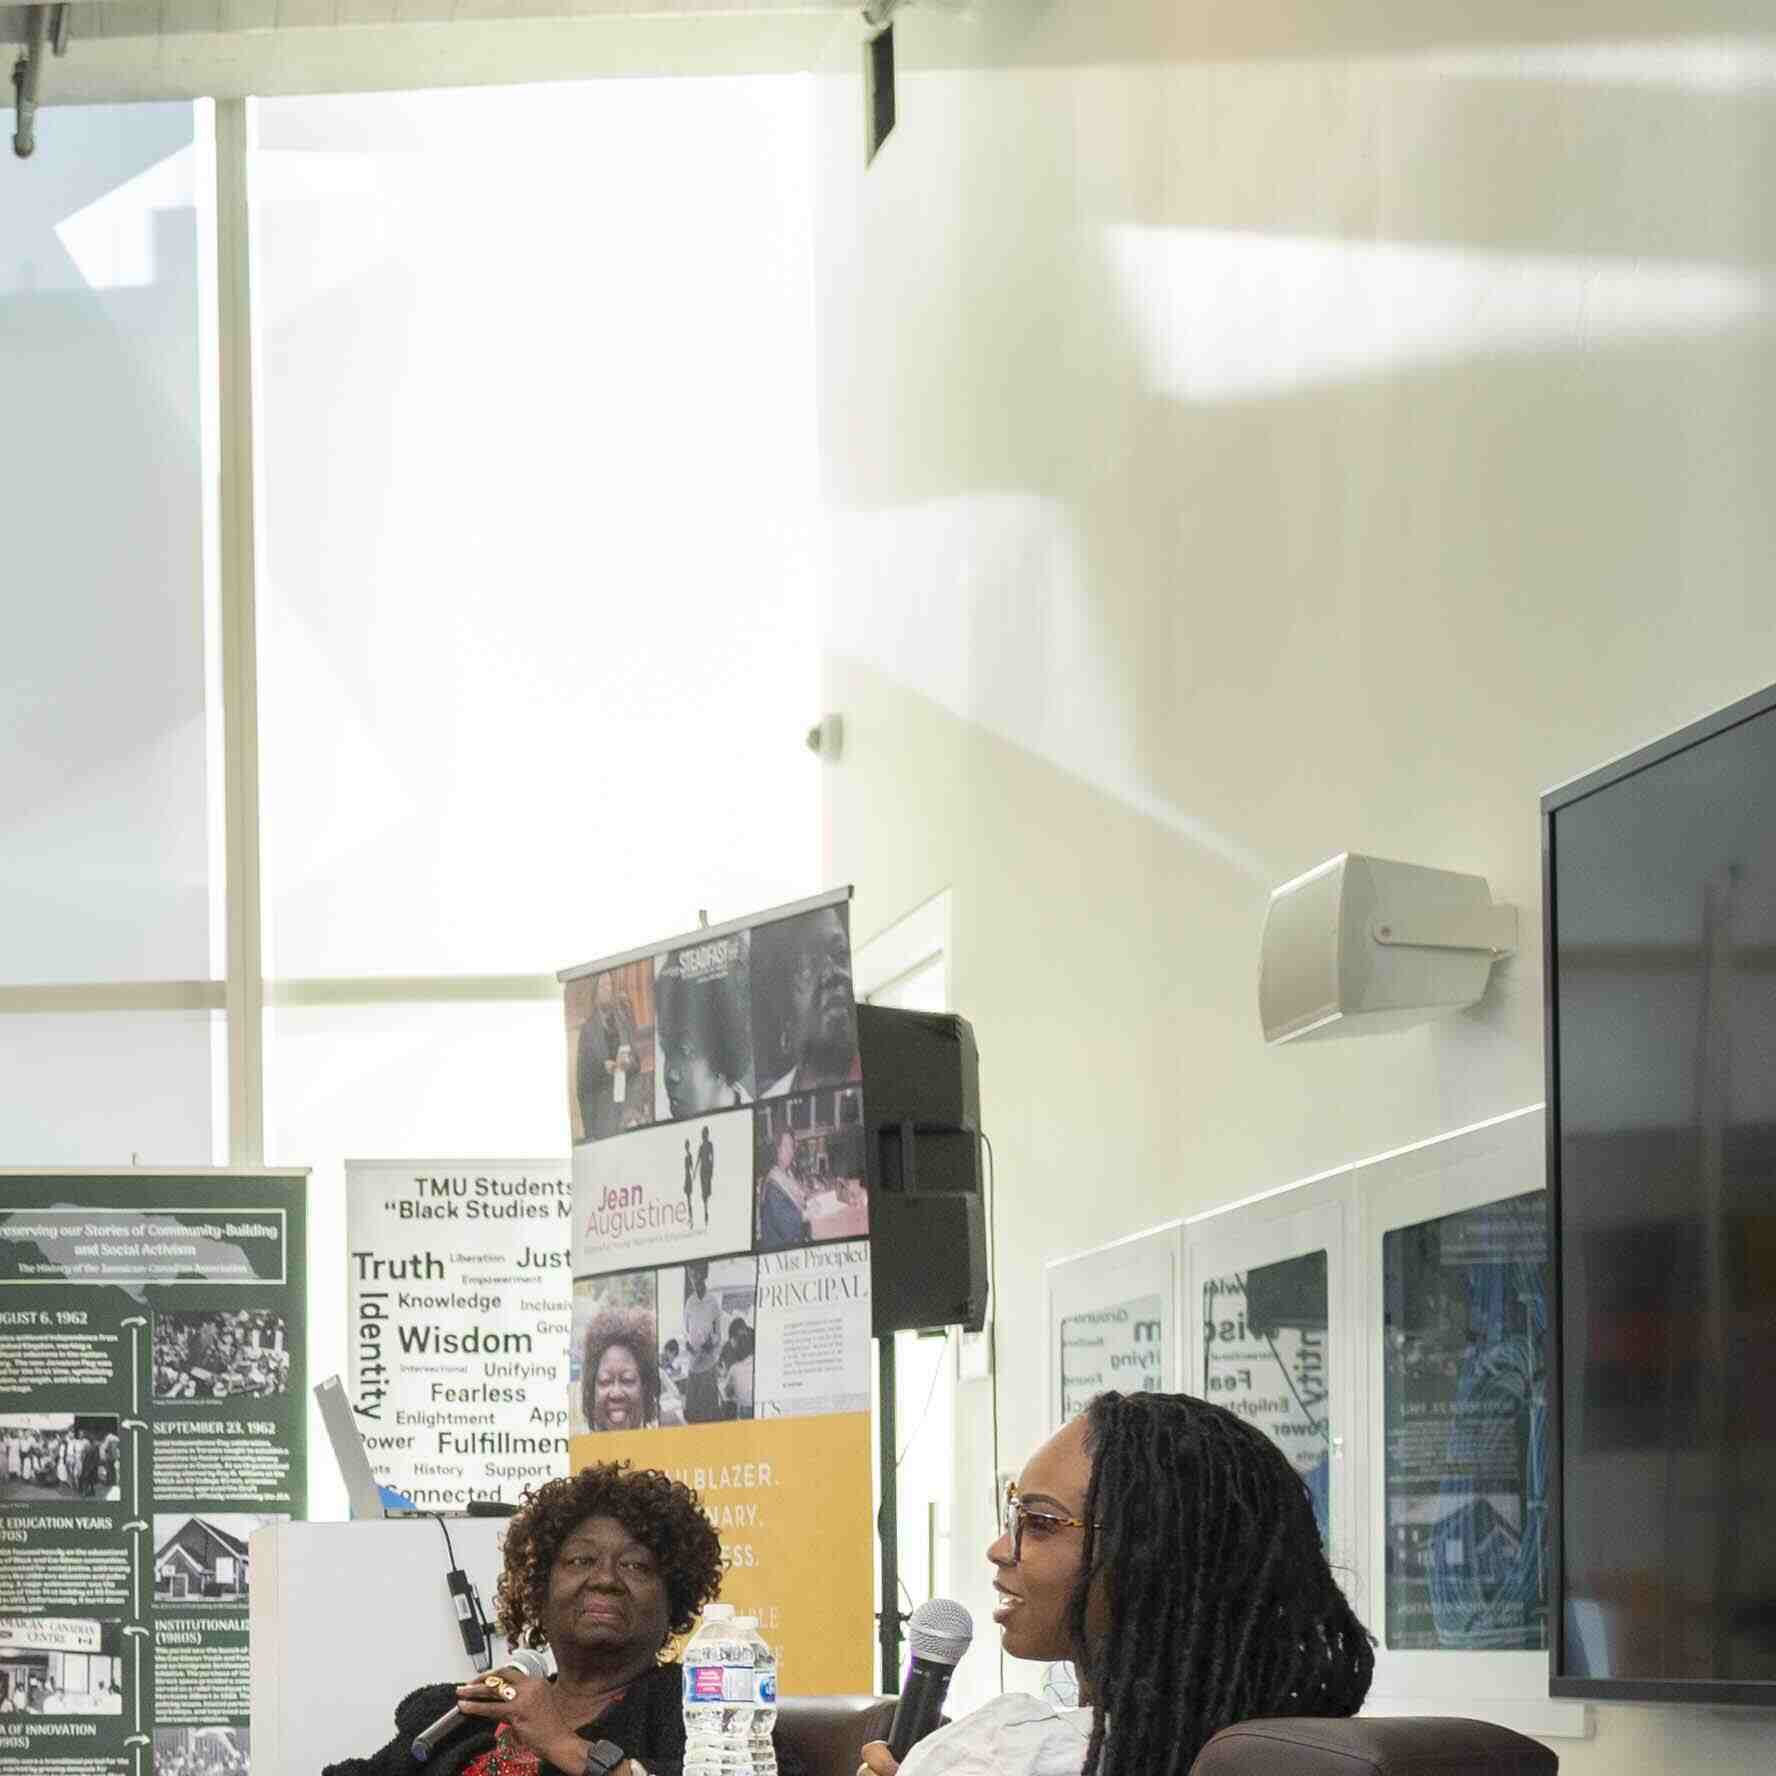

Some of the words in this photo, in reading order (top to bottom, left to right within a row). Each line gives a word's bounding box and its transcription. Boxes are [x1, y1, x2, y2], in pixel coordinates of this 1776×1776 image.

[415, 1178, 468, 1197] TMU
[598, 1184, 643, 1213] Jean
[466, 1200, 550, 1219] Studies
[585, 1200, 688, 1239] Augustine
[60, 1226, 83, 1237] our
[84, 1224, 130, 1237] Stories
[131, 1223, 145, 1237] of
[148, 1223, 279, 1239] Community-Building
[74, 1245, 99, 1257] and
[100, 1245, 140, 1257] Social
[141, 1244, 197, 1257] Activism
[352, 1252, 445, 1280] Truth
[449, 1253, 506, 1264] Liberation
[517, 1247, 572, 1268] Just
[759, 1275, 869, 1309] PRINCIPAL
[398, 1293, 502, 1313] Knowledge
[56, 1311, 88, 1325] 1962
[537, 1321, 570, 1334] Grou
[397, 1325, 533, 1353] Wisdom
[354, 1293, 390, 1420] Identity
[484, 1362, 557, 1380] Unifying
[431, 1383, 527, 1402] Fearless
[396, 1410, 495, 1428] Enlightment
[529, 1407, 568, 1427] App
[153, 1421, 224, 1434] SEPTEMBER
[246, 1421, 276, 1434] 1962
[438, 1432, 569, 1454] Fulfillmen
[413, 1463, 464, 1478] History
[484, 1462, 552, 1478] Support
[6, 1517, 74, 1529] EDUCATION
[75, 1516, 113, 1529] YEARS
[709, 1503, 765, 1528] NARY.
[8, 1724, 23, 1736] OF
[25, 1723, 97, 1736] INNOVATION
